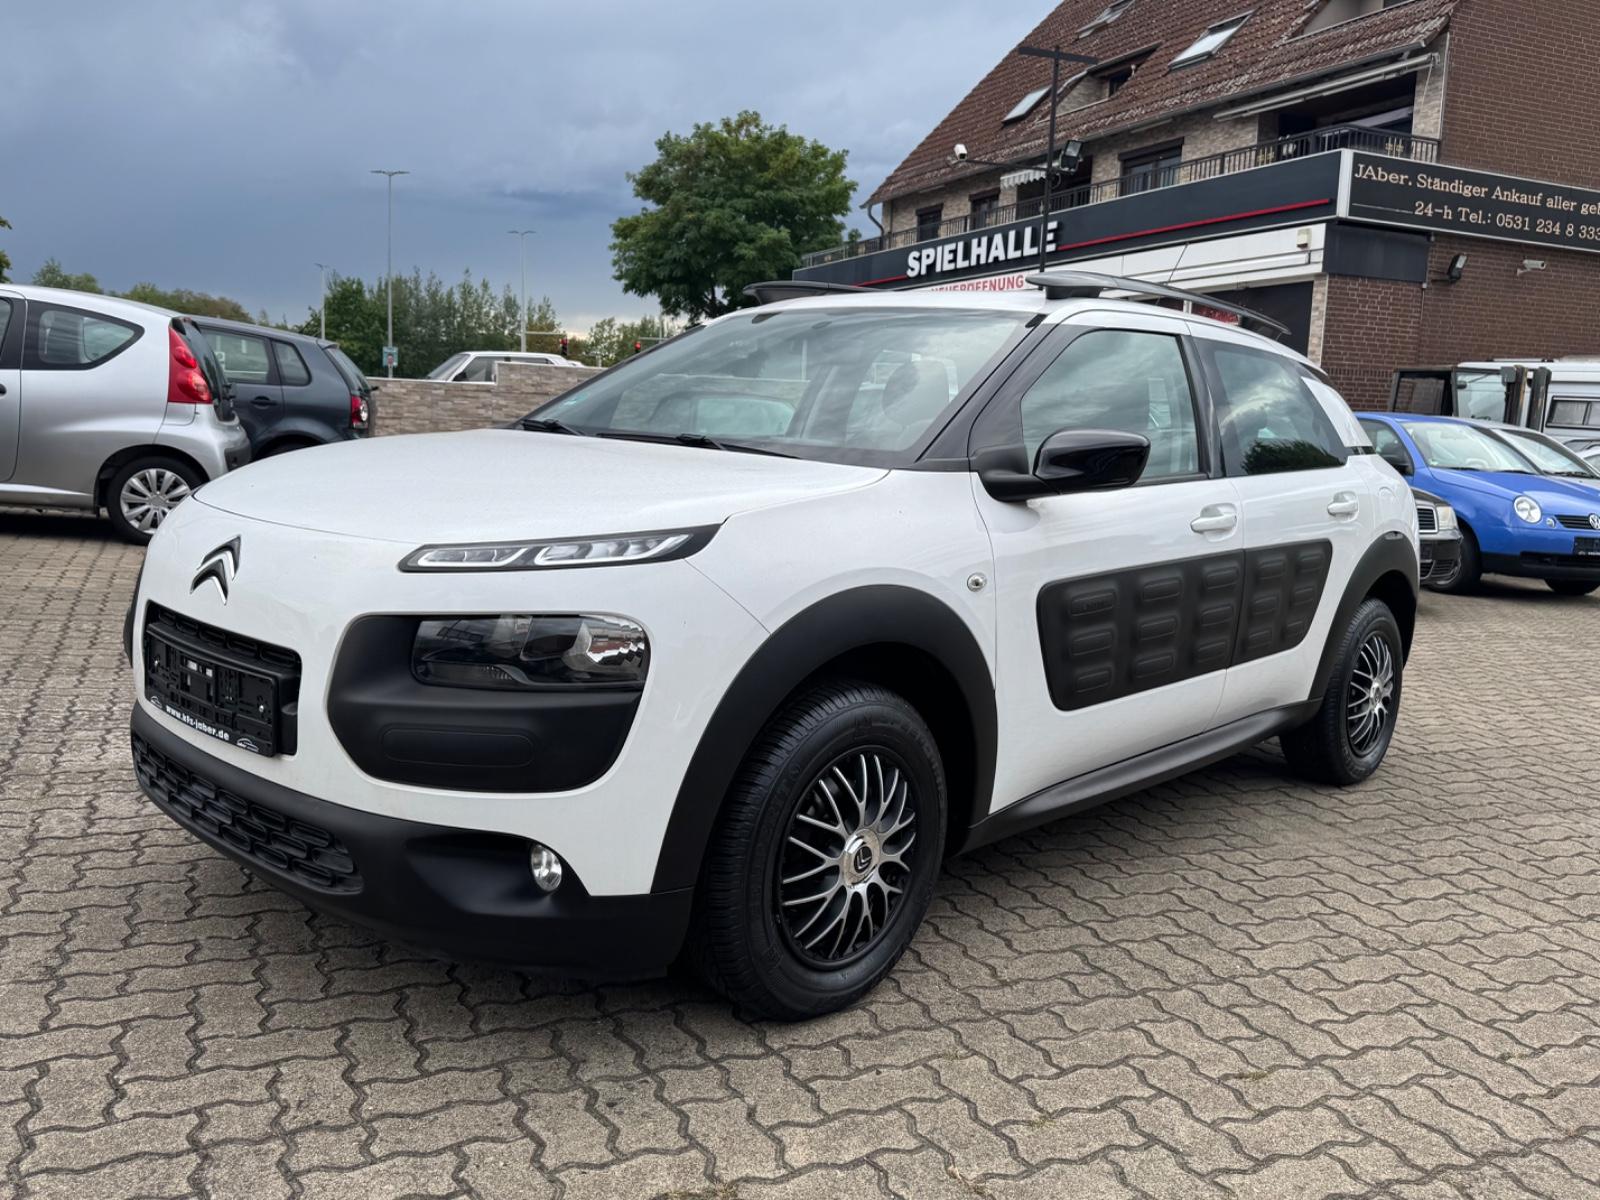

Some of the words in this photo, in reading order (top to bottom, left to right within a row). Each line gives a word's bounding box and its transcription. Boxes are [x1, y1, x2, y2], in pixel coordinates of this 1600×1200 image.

[1354, 163, 1412, 186] JAber.
[1416, 173, 1488, 198] Ständiger
[1491, 185, 1543, 206] Ankauf
[1546, 195, 1577, 211] aller
[1414, 201, 1453, 220] 24-h
[1457, 206, 1491, 225] Tel.:
[1496, 213, 1530, 231] 0531
[1535, 218, 1561, 235] 234
[1565, 223, 1574, 237] 8
[906, 220, 1058, 278] SPIELHALLE
